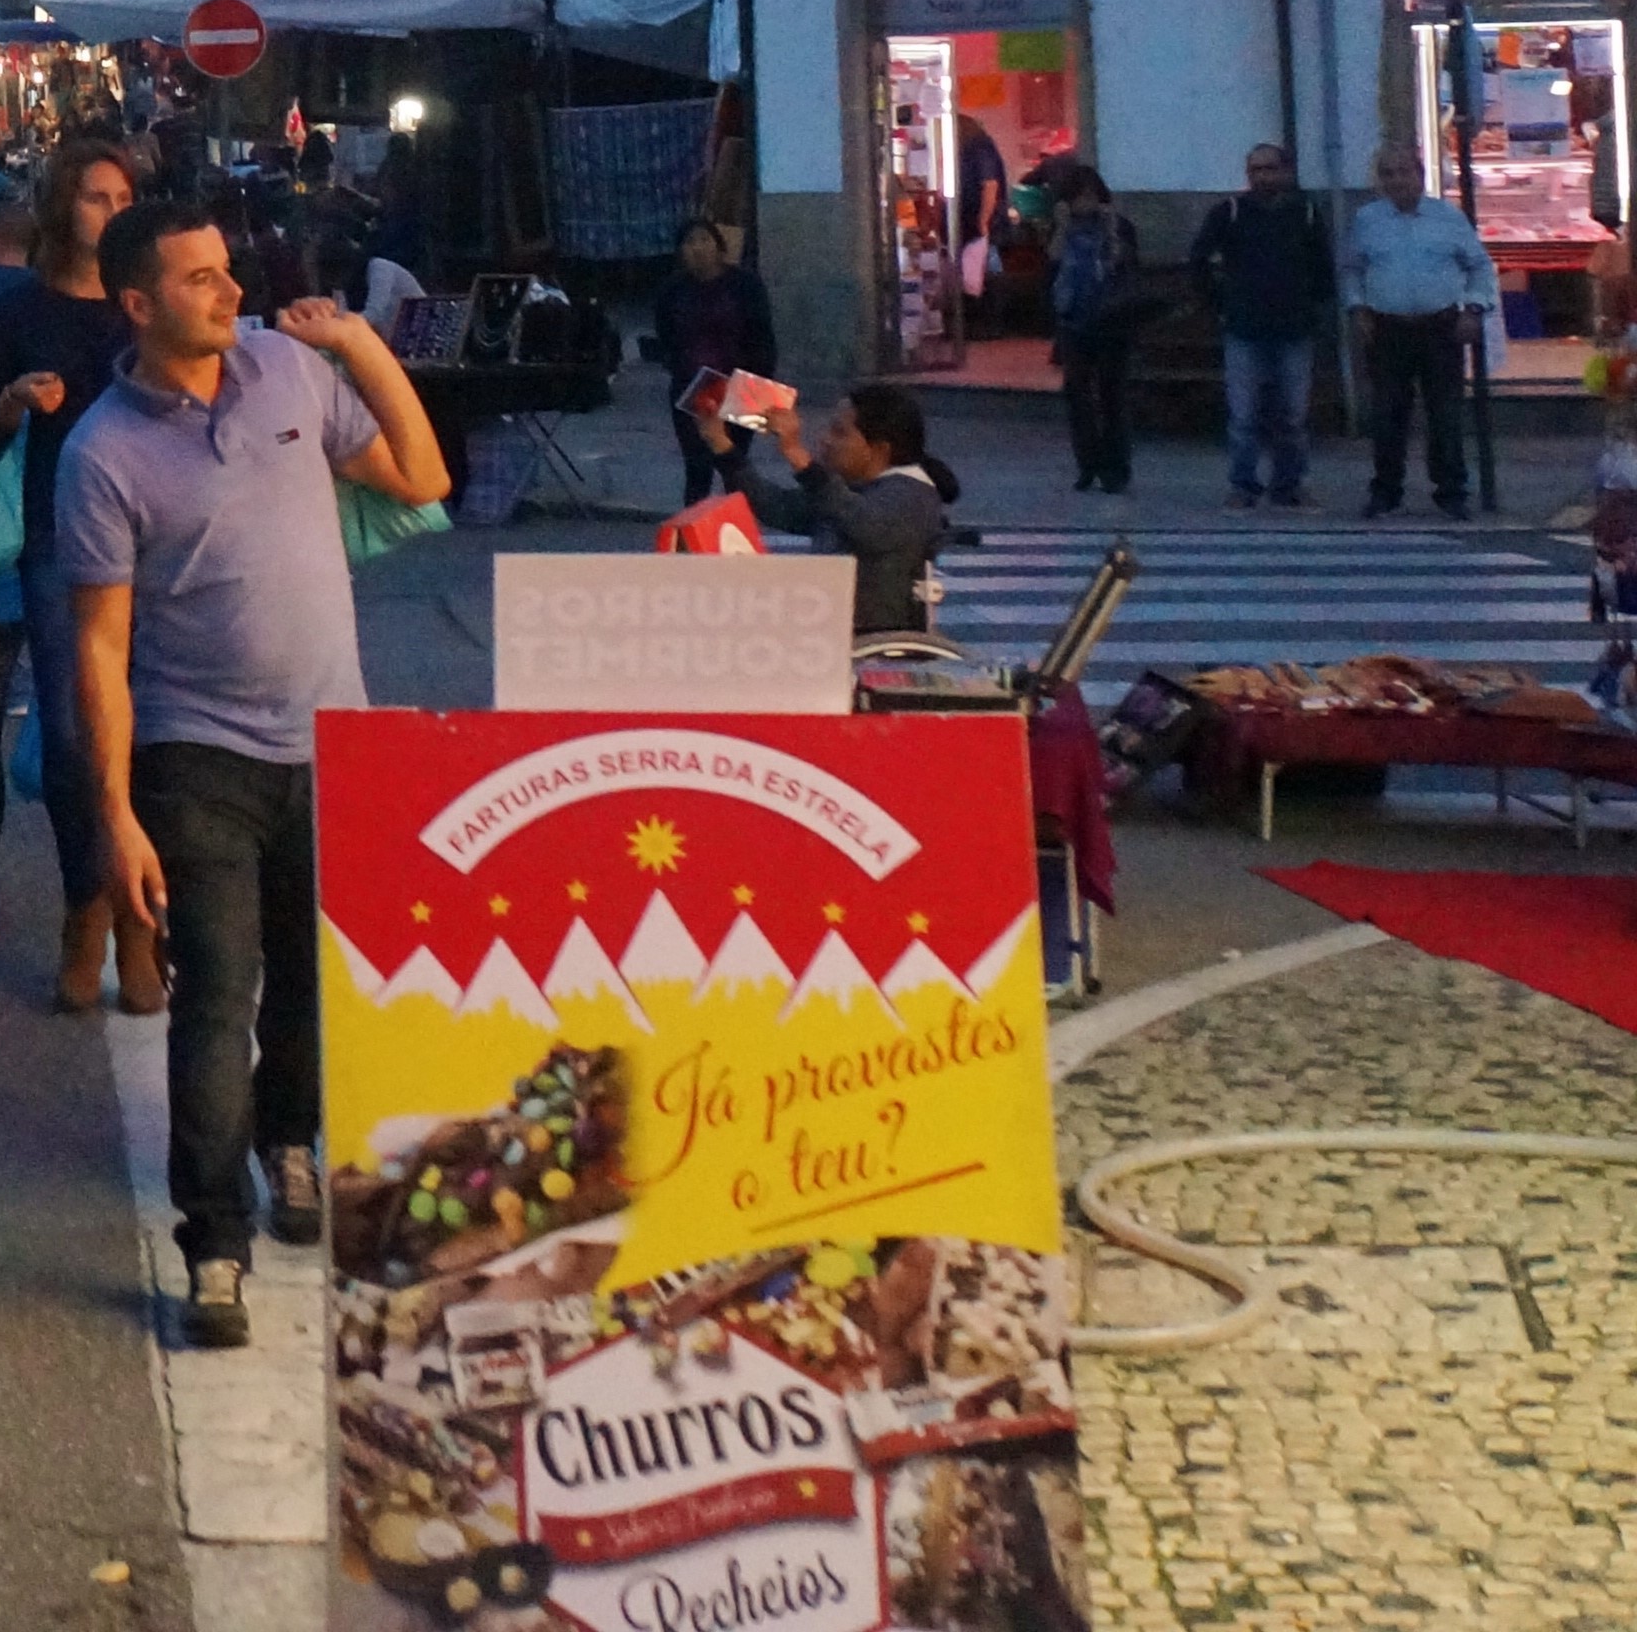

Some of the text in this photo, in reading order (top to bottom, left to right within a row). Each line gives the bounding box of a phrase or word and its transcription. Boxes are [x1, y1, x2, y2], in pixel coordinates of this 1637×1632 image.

[447, 749, 893, 865] FARTURAS SERRA DA ESTRELA
[640, 996, 1019, 1188] Já provastes
[731, 1098, 908, 1212] o teu?
[535, 1384, 827, 1489] Churros
